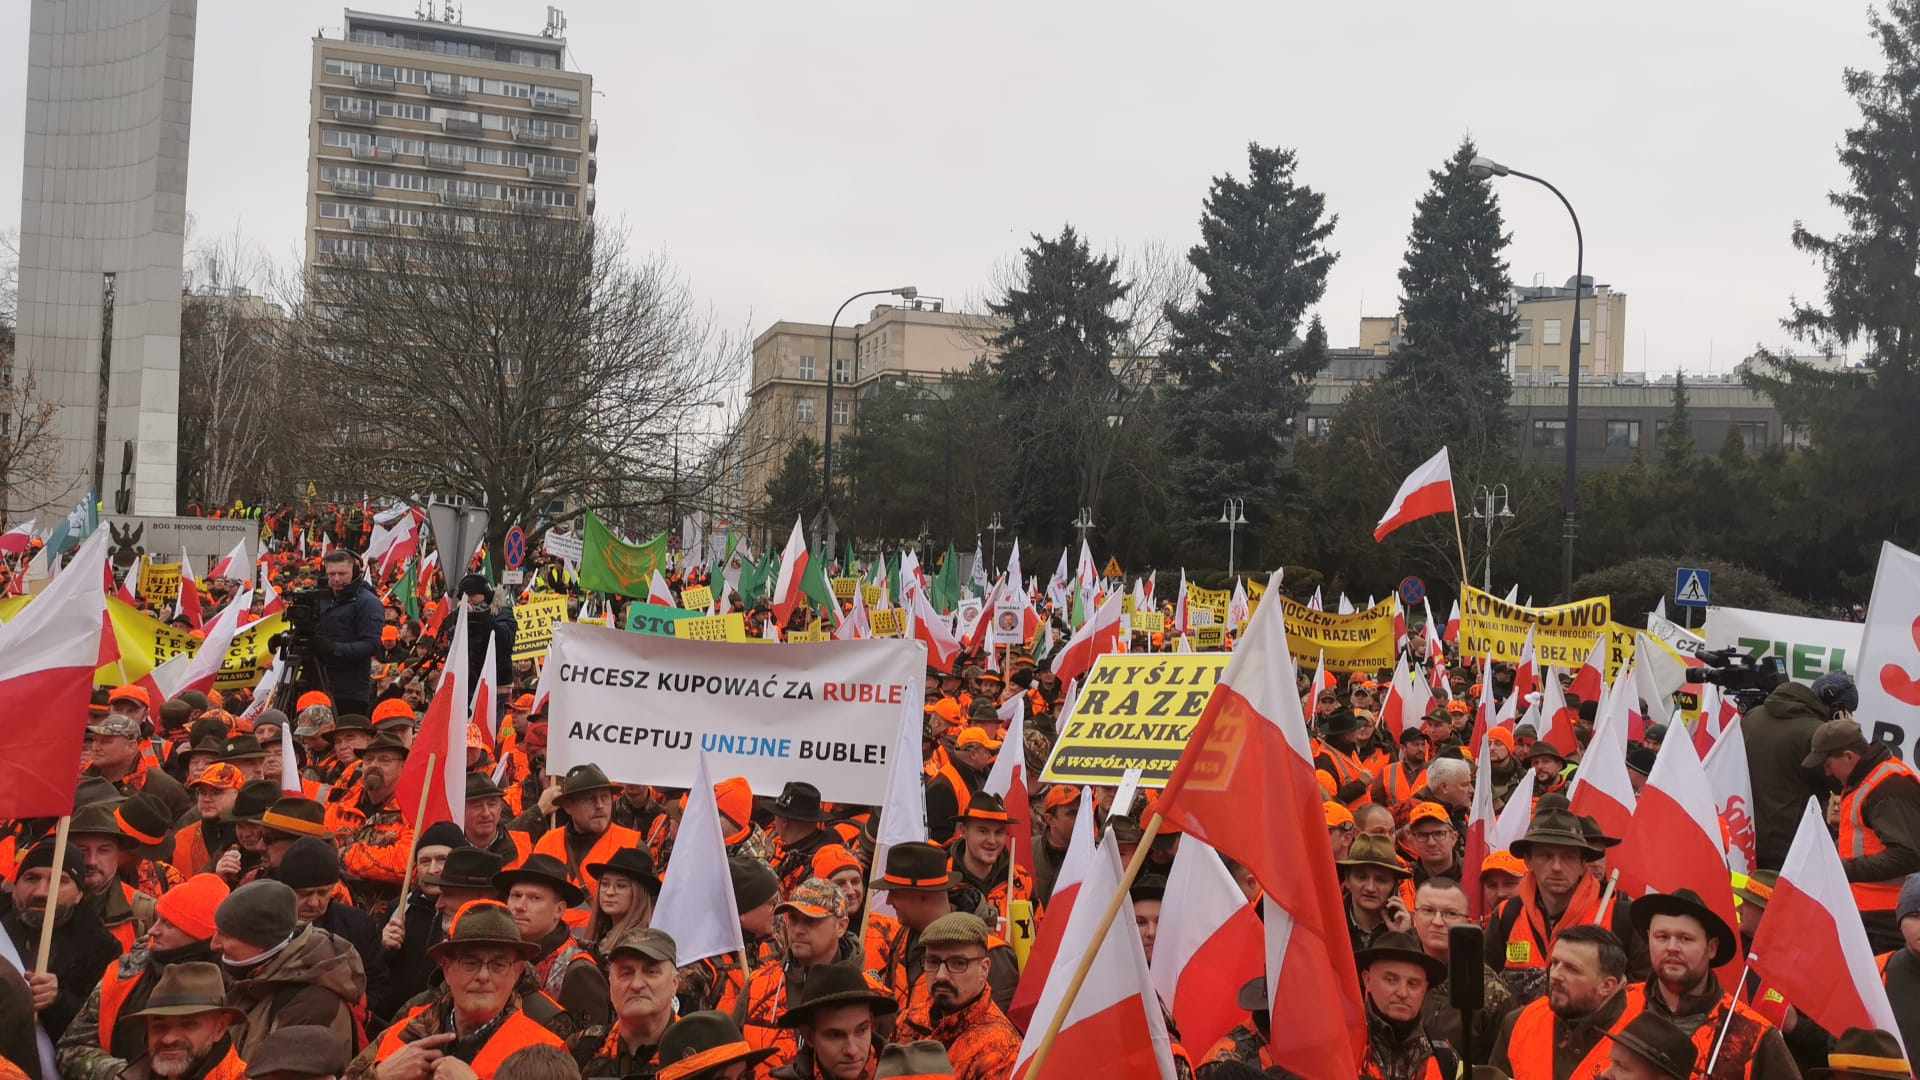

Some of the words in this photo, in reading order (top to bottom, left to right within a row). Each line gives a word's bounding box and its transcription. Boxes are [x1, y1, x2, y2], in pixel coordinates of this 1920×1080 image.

[516, 604, 561, 620] ŚLIWI
[632, 614, 676, 634] STO
[1284, 618, 1318, 640] ŚLIWI
[1467, 635, 1491, 653] NIC
[1496, 639, 1505, 655] O
[1510, 640, 1536, 658] NA
[1541, 644, 1567, 661] BEZ
[1572, 646, 1591, 662] NA
[1676, 639, 1706, 654] CZE
[1738, 636, 1854, 681] ZIEL
[559, 663, 650, 689] CHCESZ
[657, 672, 778, 699] KUPOWAĆ
[782, 681, 814, 700] ZA
[822, 682, 908, 704] RUBLE
[1077, 689, 1209, 717] RAZE
[568, 720, 693, 750] AKCEPTUJ
[701, 733, 791, 758] UNIJNE
[799, 741, 888, 765] BUBLE!
[1066, 721, 1084, 739] Z
[1085, 721, 1197, 742] ROLNIKA
